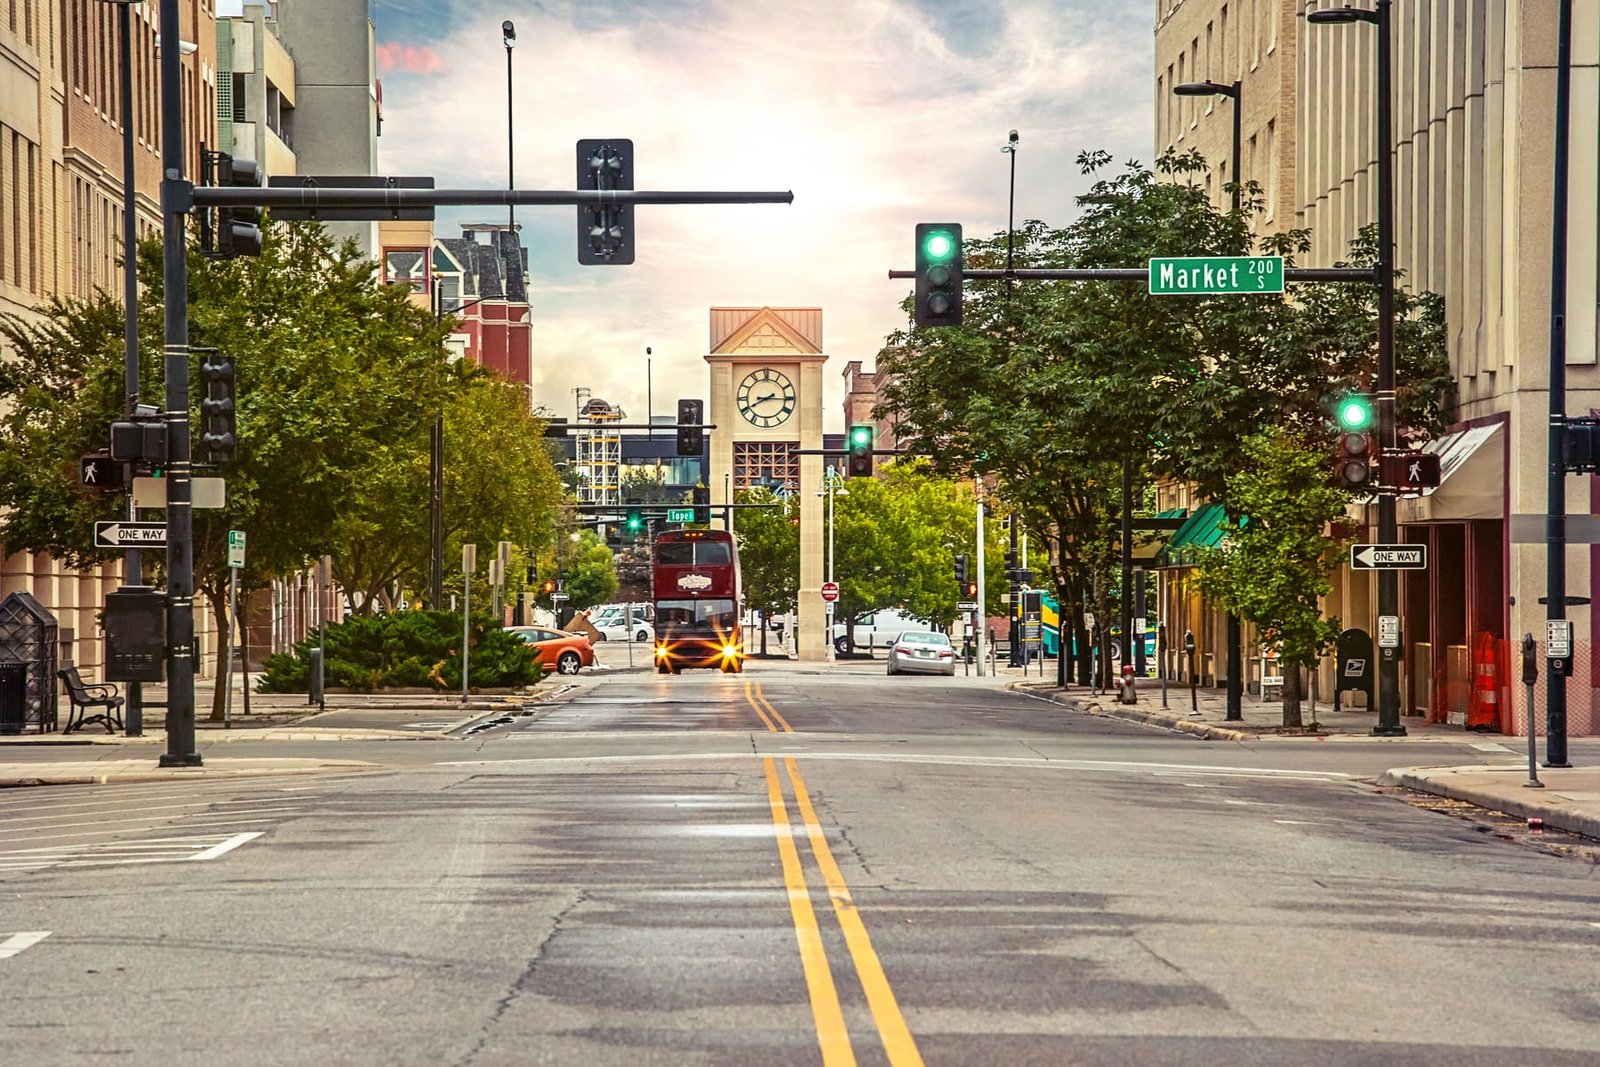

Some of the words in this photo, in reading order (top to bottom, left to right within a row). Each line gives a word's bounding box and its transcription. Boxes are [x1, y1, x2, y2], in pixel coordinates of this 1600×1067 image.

[1248, 260, 1274, 274] 200
[1160, 263, 1239, 289] Market
[1257, 275, 1265, 289] S
[118, 529, 139, 539] ONE
[142, 529, 164, 539] WAY
[1373, 552, 1394, 562] ONE
[1396, 552, 1418, 562] WAY
